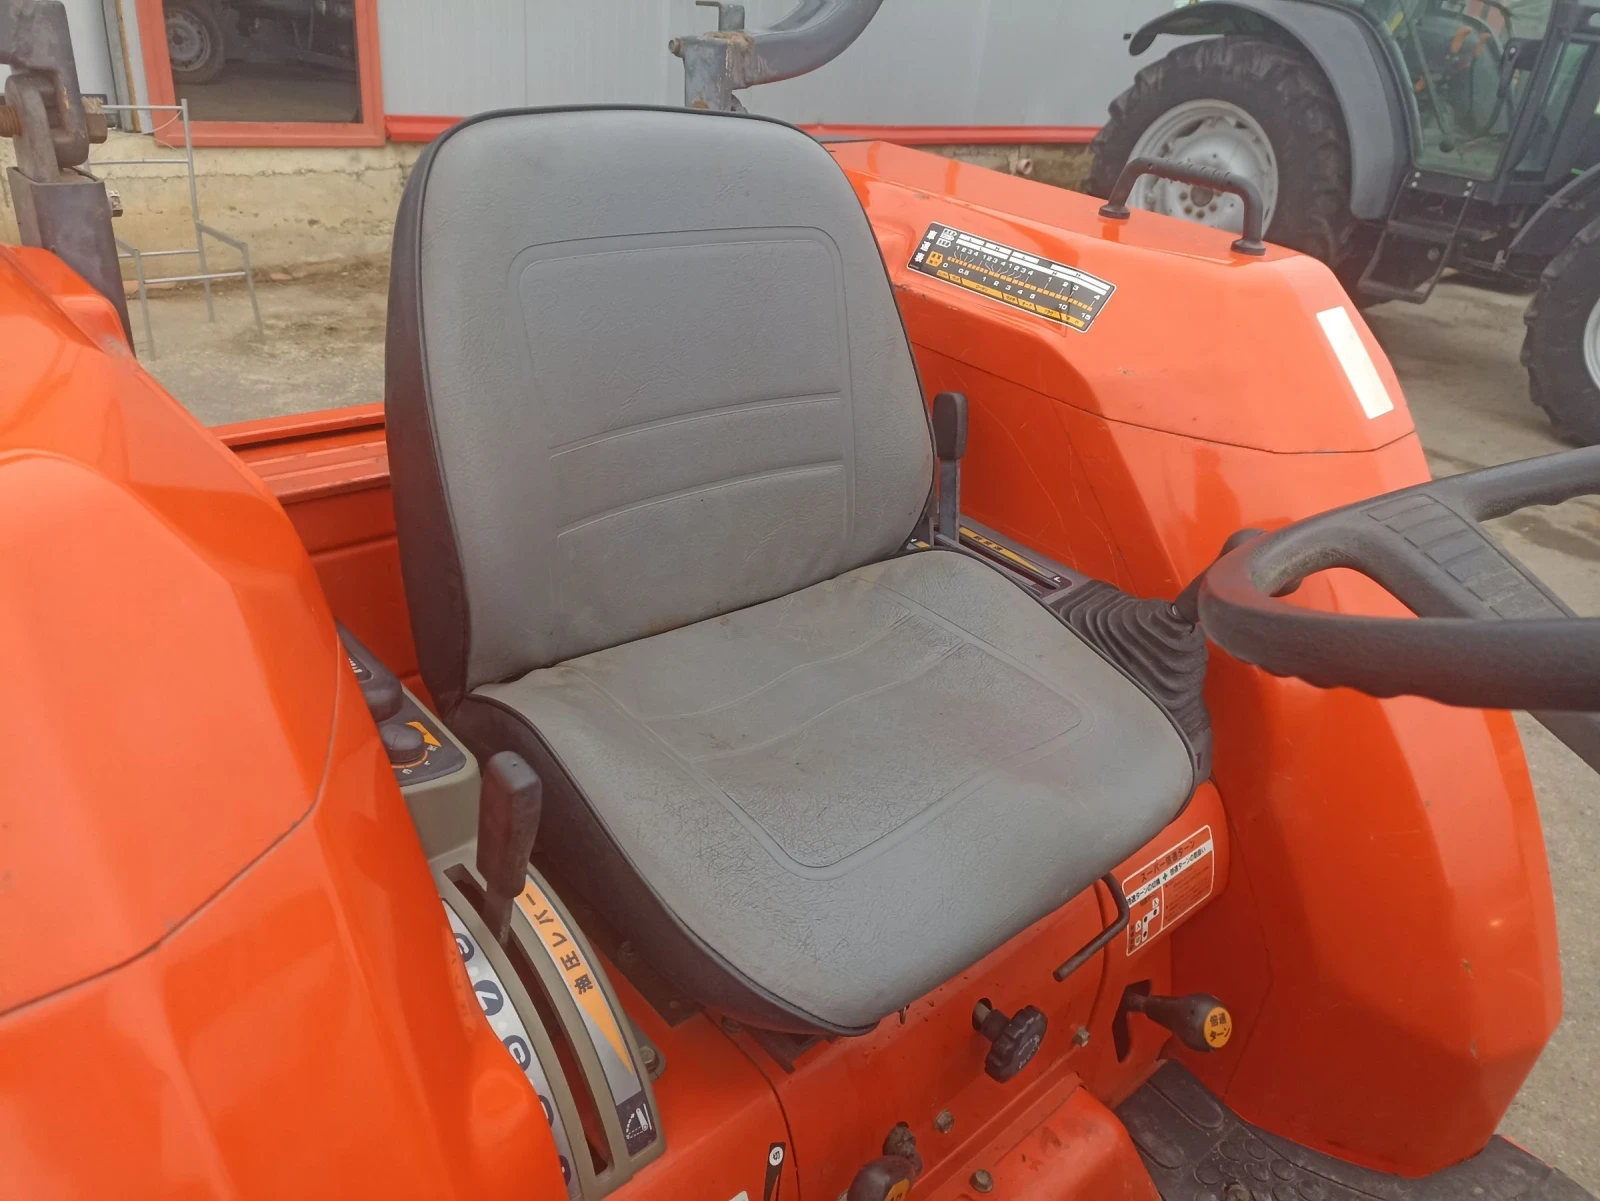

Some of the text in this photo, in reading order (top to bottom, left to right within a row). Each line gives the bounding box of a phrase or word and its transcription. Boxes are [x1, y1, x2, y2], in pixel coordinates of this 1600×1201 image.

[526, 893, 594, 995] 油圧レバー
[475, 990, 498, 1011] 7
